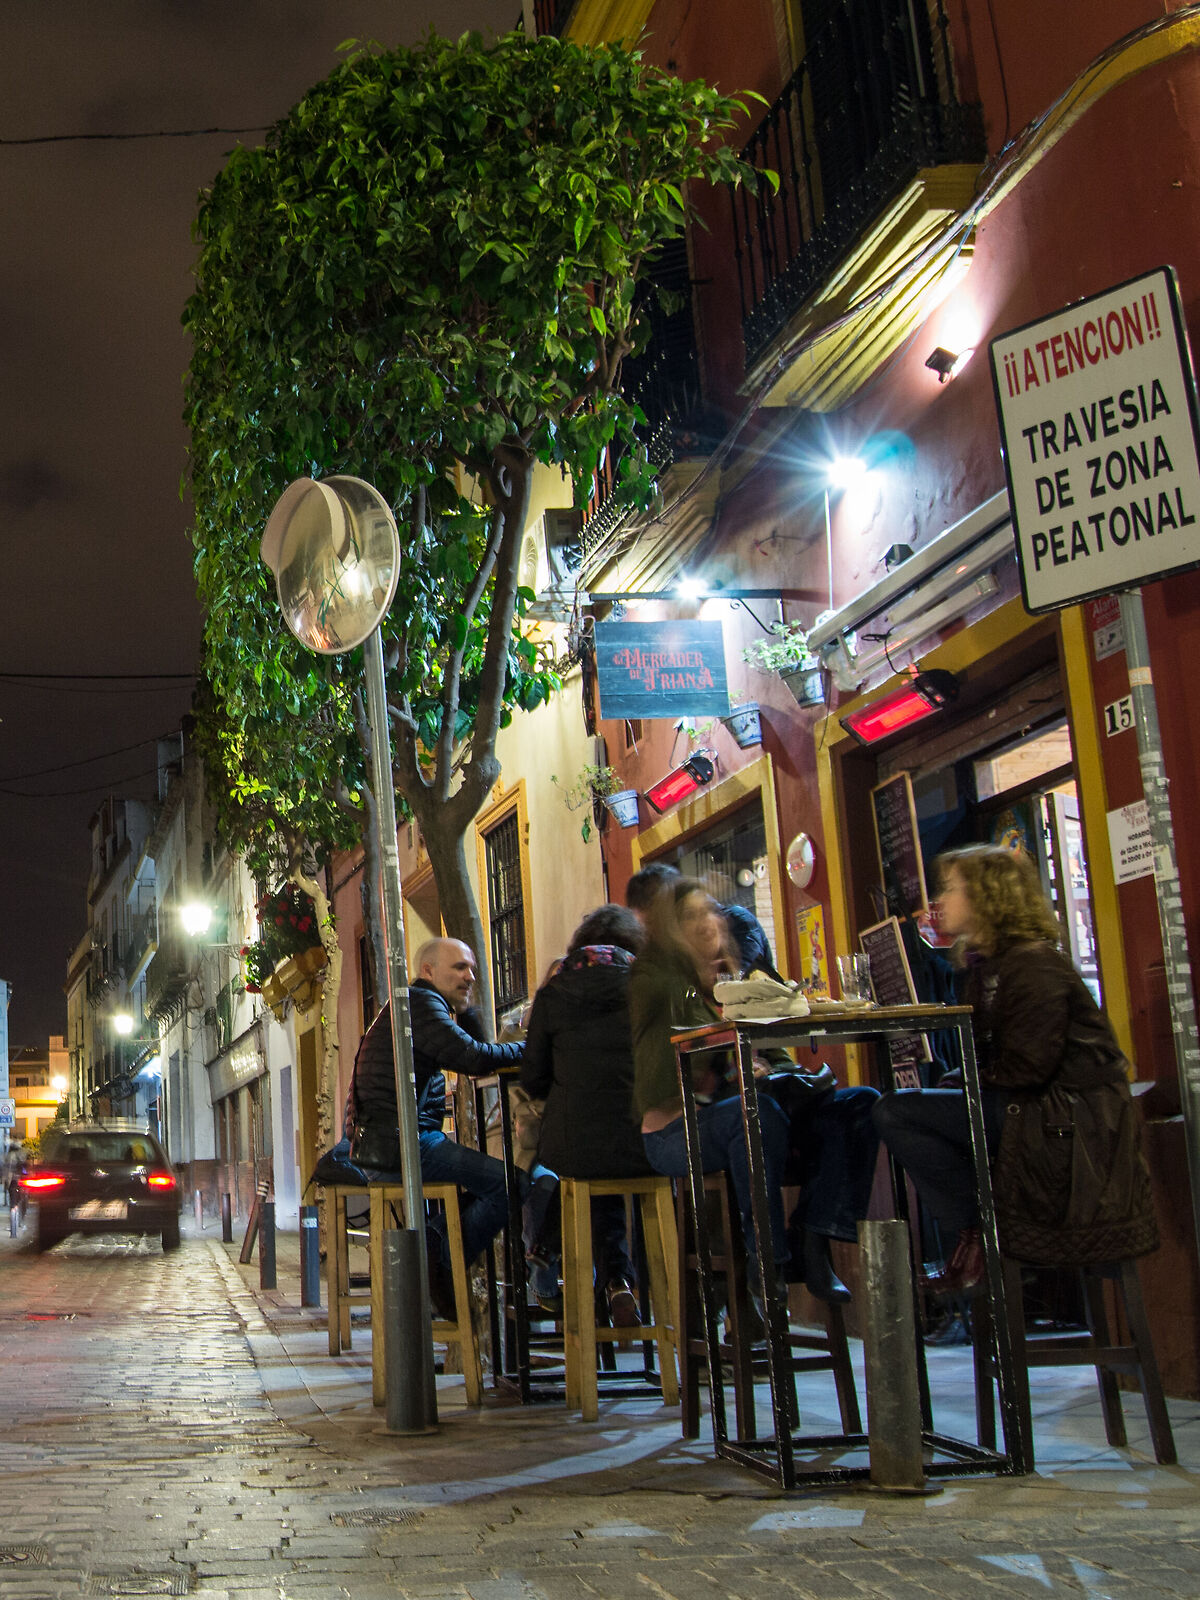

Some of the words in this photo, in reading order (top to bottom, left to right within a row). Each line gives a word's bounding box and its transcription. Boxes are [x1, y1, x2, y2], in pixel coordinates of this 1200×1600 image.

[1022, 379, 1172, 464] TRAVESIA
[1035, 469, 1075, 516] DE
[1086, 435, 1174, 499] ZONA
[1031, 487, 1196, 572] PEATONAL
[1105, 698, 1131, 734] 15
